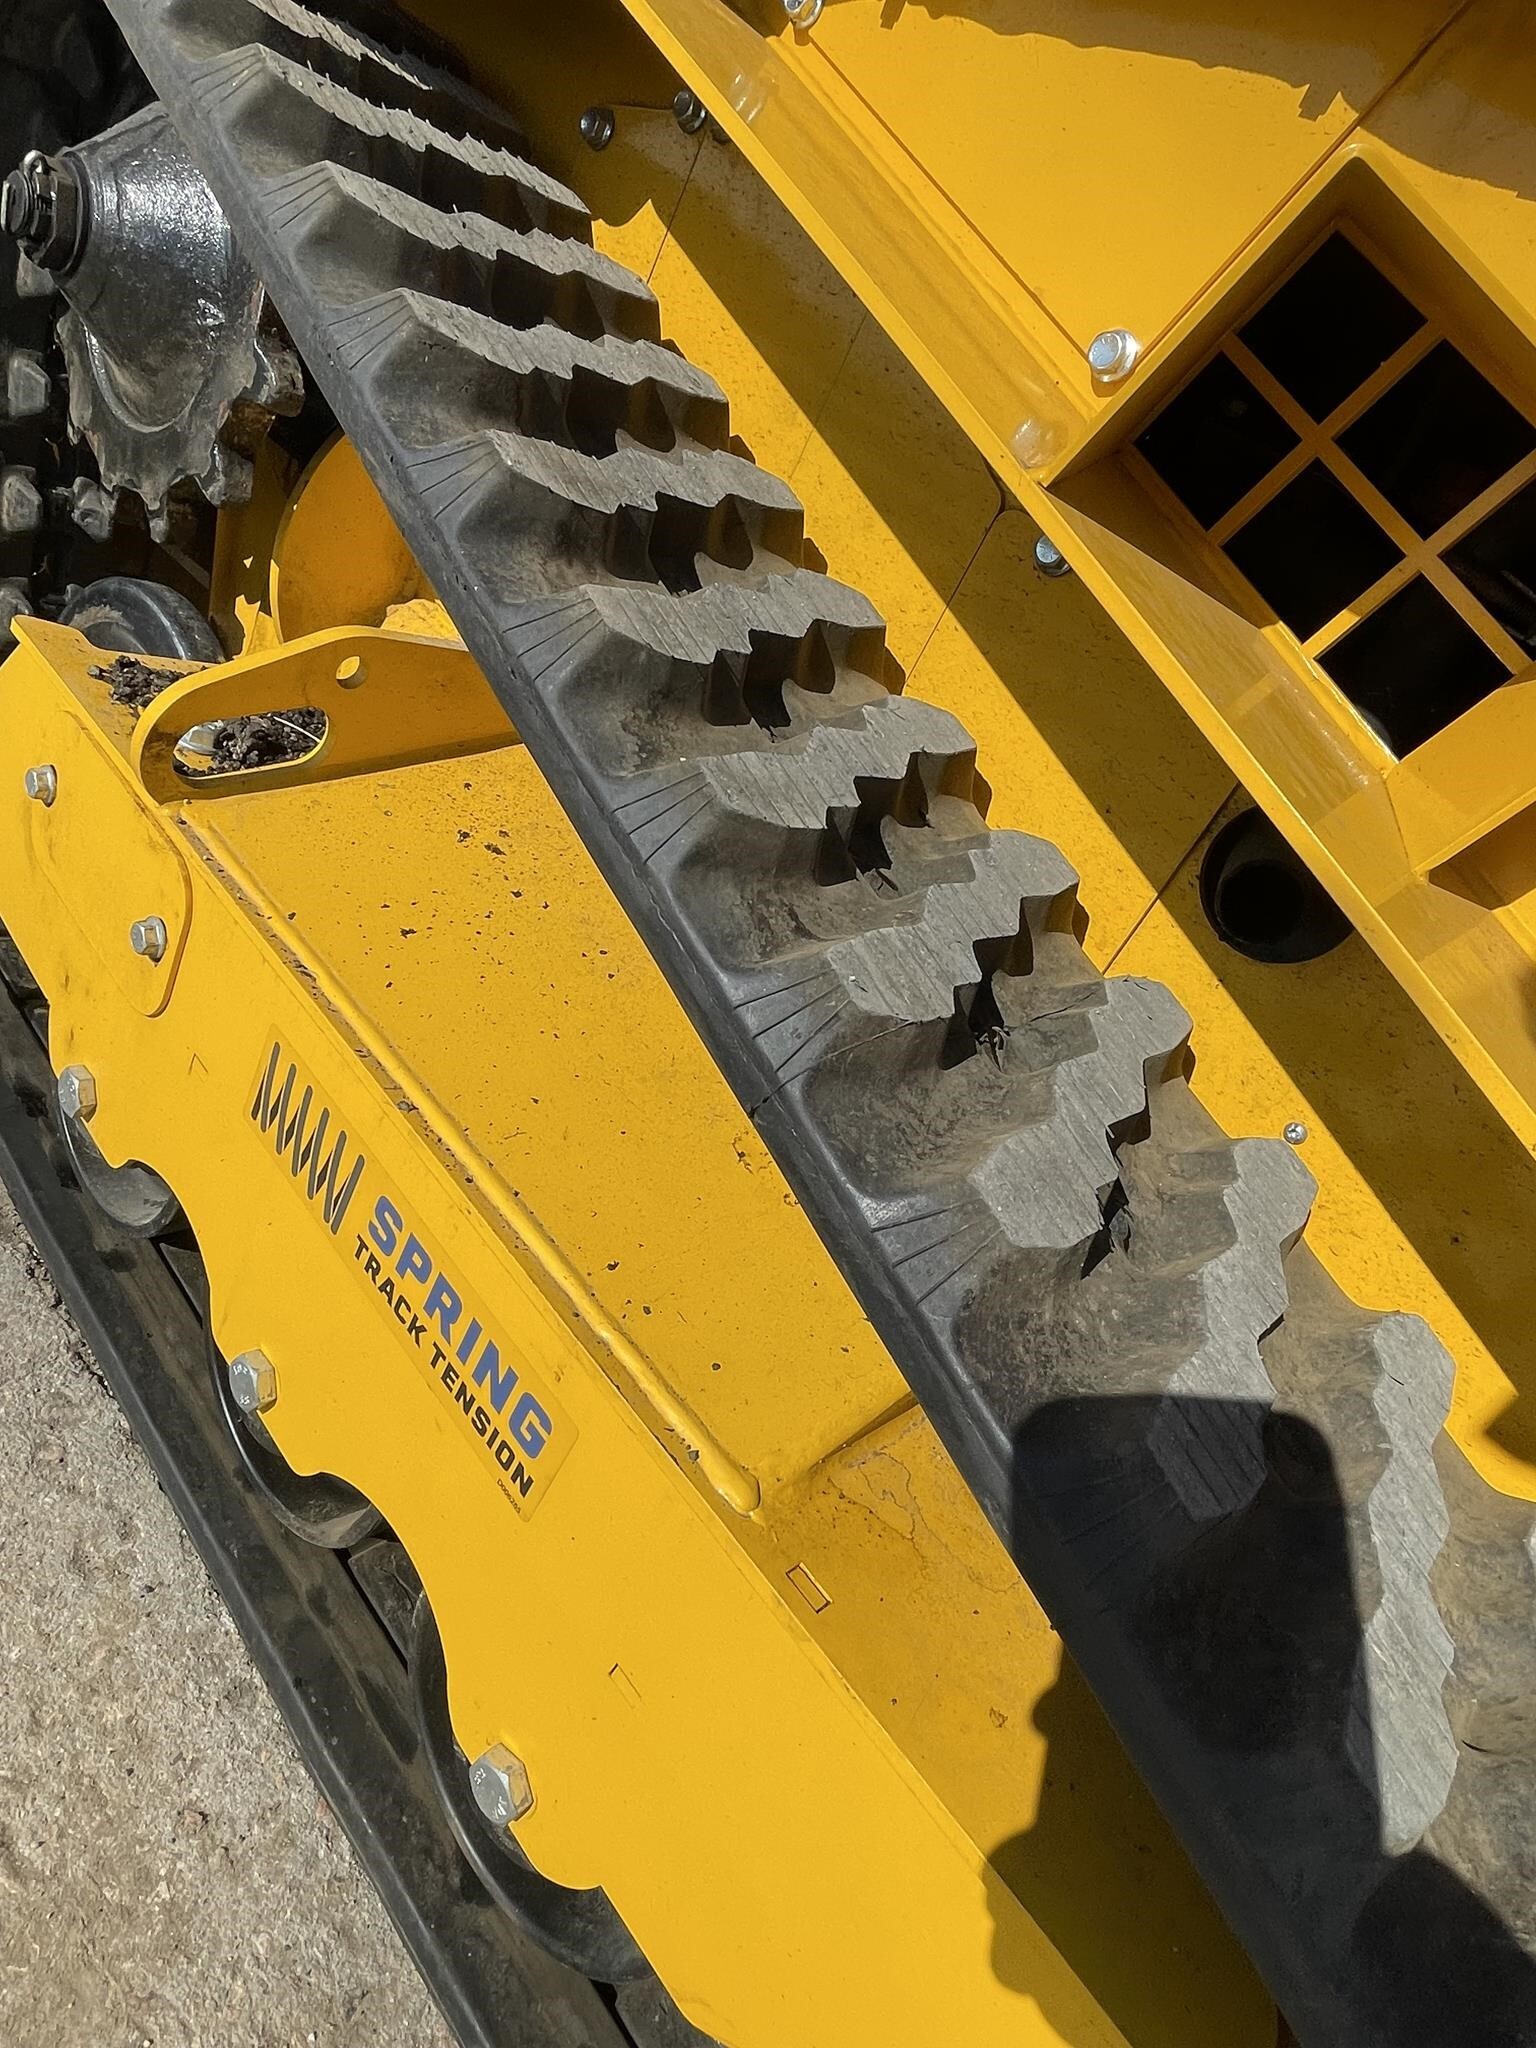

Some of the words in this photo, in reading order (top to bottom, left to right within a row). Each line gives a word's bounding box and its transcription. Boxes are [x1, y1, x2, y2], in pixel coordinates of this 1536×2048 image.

[355, 1234, 428, 1348] TRACK
[430, 1341, 534, 1498] TENSION
[368, 1195, 552, 1460] SPRING
